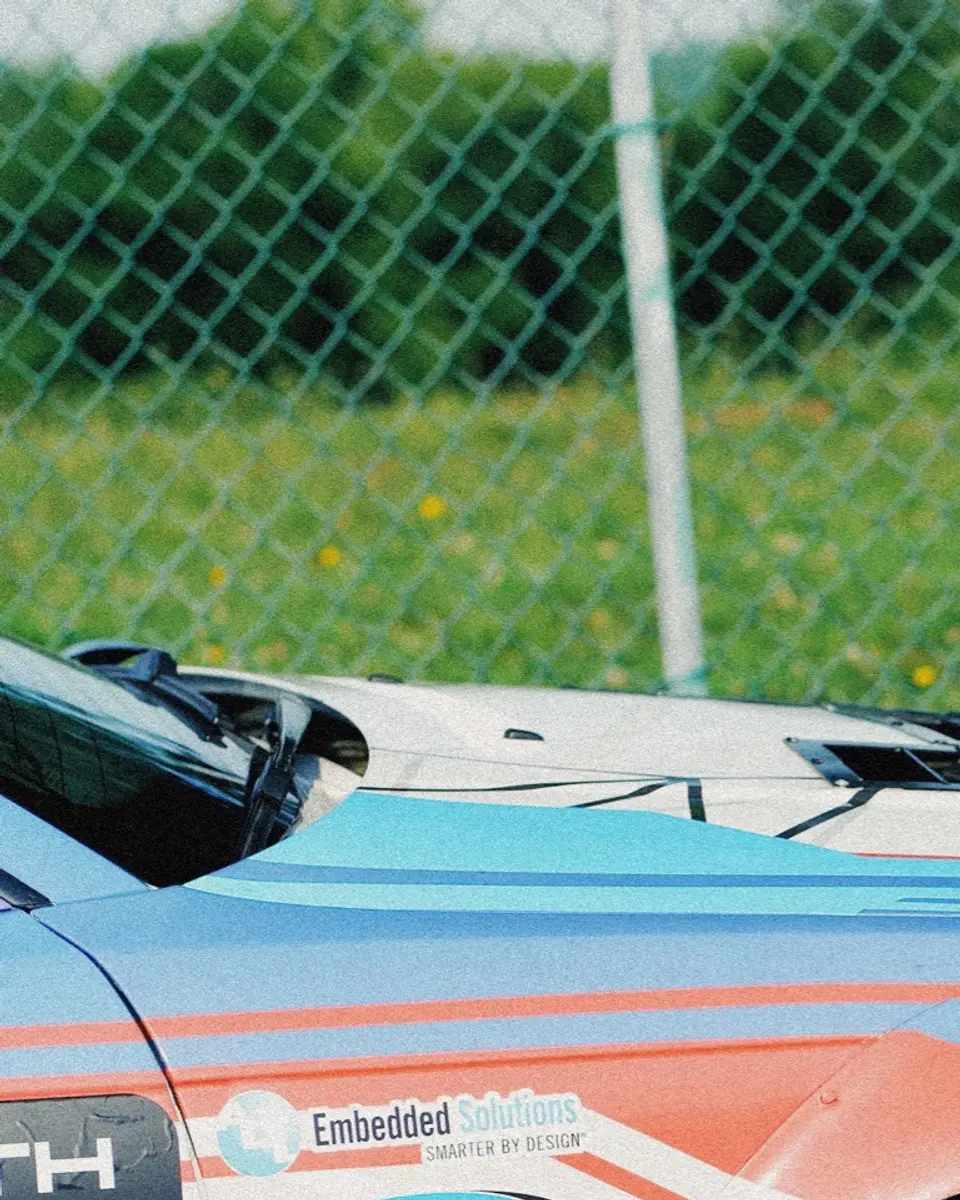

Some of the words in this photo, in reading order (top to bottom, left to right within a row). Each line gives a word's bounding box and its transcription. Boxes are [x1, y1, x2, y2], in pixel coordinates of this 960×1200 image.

[312, 1103, 451, 1147] Embedded
[458, 1094, 577, 1133] Solutions
[427, 1143, 496, 1162] SMARTER
[501, 1138, 521, 1155] BY
